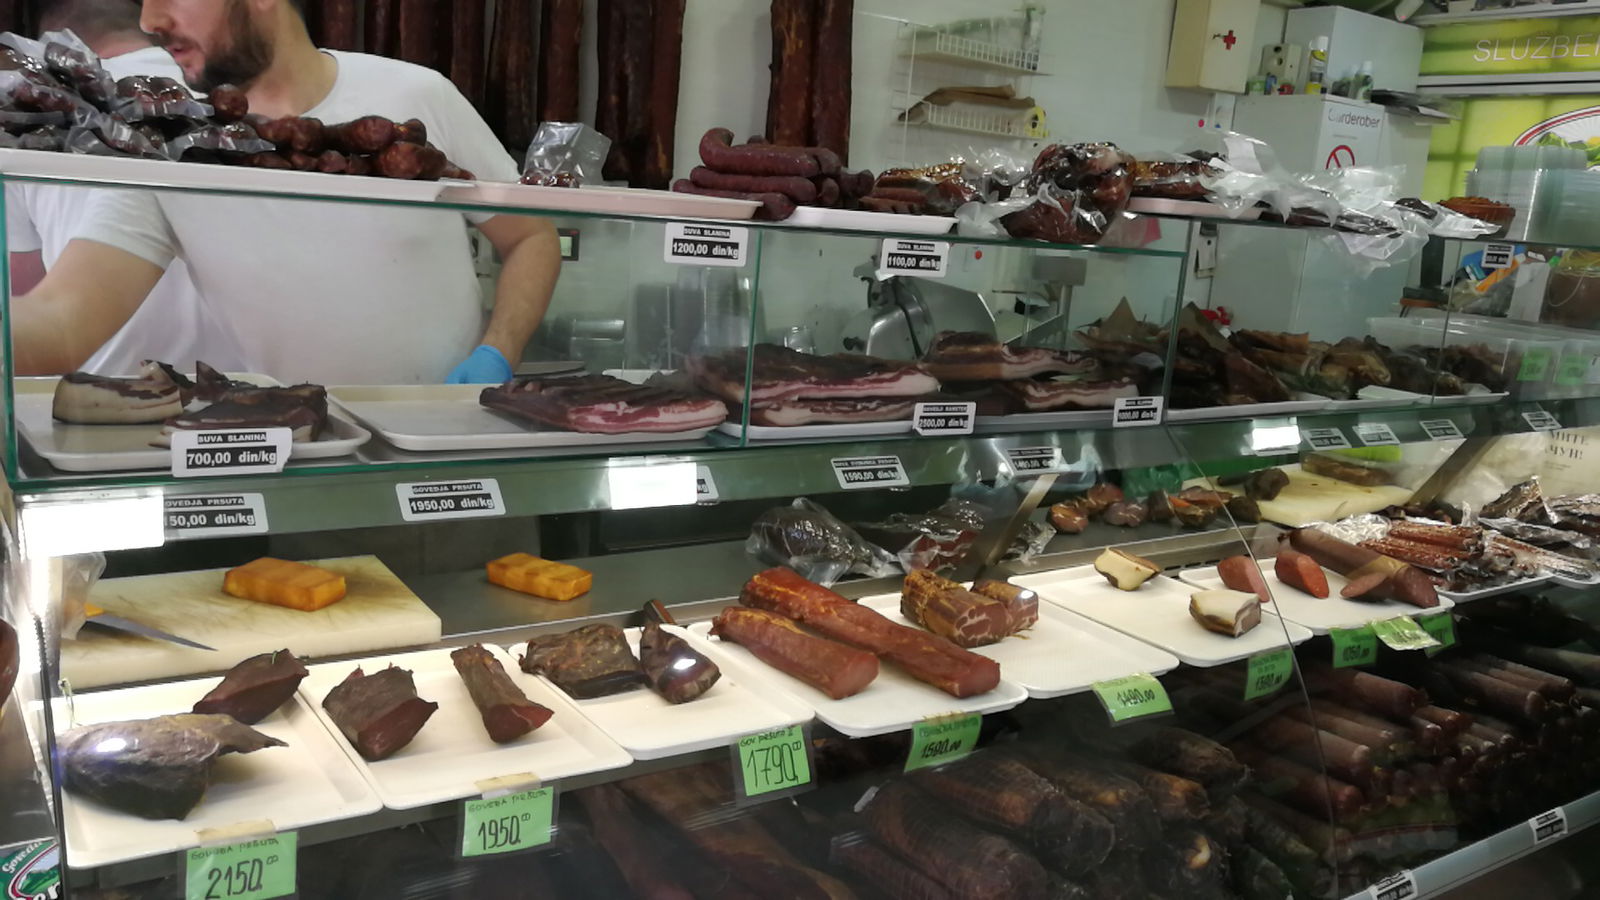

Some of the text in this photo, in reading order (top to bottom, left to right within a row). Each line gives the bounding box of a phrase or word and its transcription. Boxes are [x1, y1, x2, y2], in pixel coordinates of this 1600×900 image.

[672, 242, 708, 255] 1200,00
[888, 256, 917, 268] 1100,00
[198, 433, 267, 443] SUVA SLANINA
[187, 451, 277, 466] 700,00 din/kg
[410, 497, 494, 512] 1950,00 din/kg
[215, 513, 254, 525] din/kg
